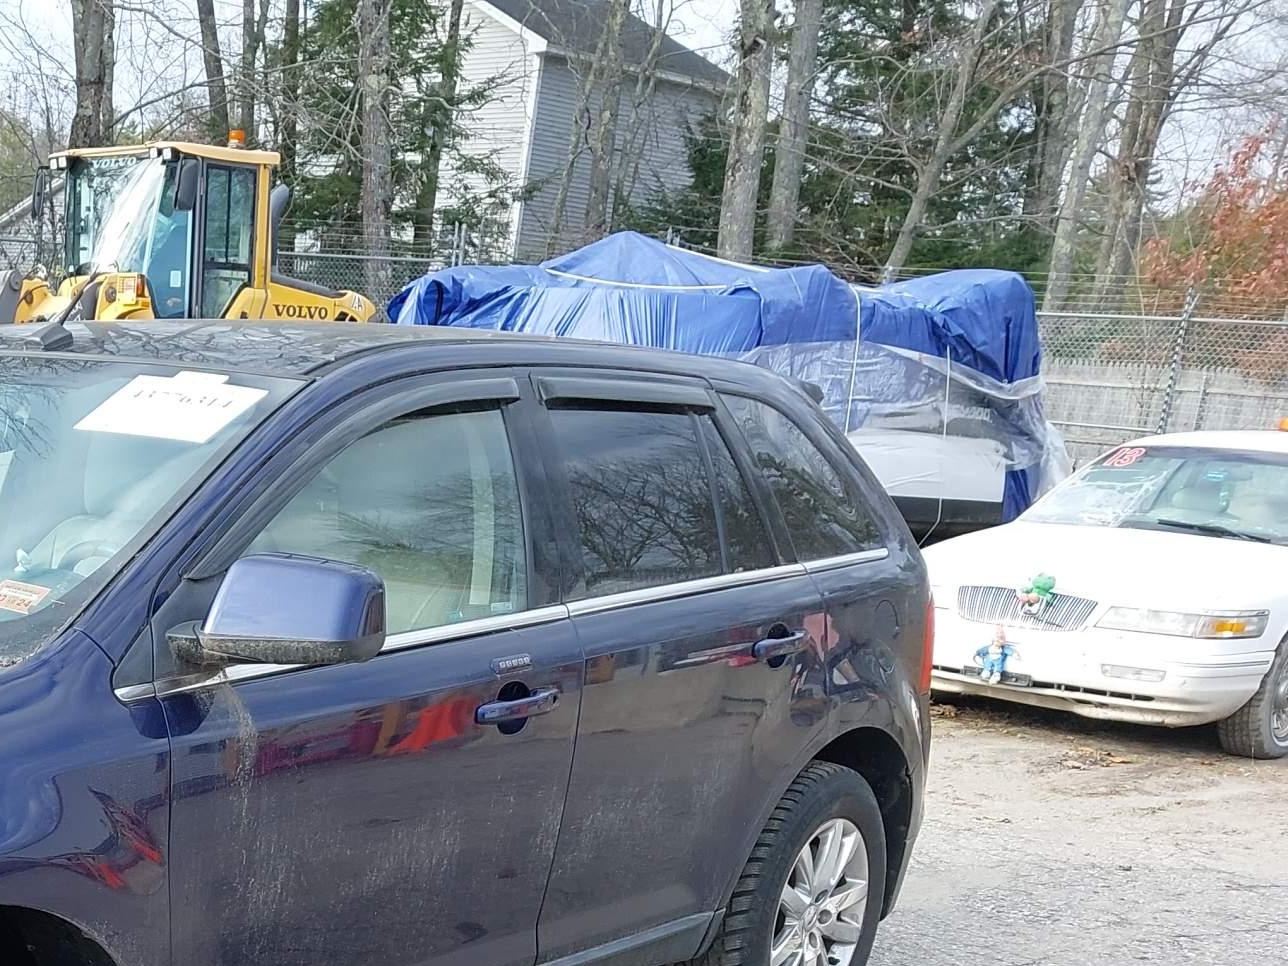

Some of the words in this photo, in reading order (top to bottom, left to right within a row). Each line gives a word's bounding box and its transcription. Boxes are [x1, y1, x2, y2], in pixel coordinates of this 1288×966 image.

[92, 156, 137, 169] VOLVO
[272, 303, 329, 320] VOLVO
[1102, 447, 1146, 467] 13
